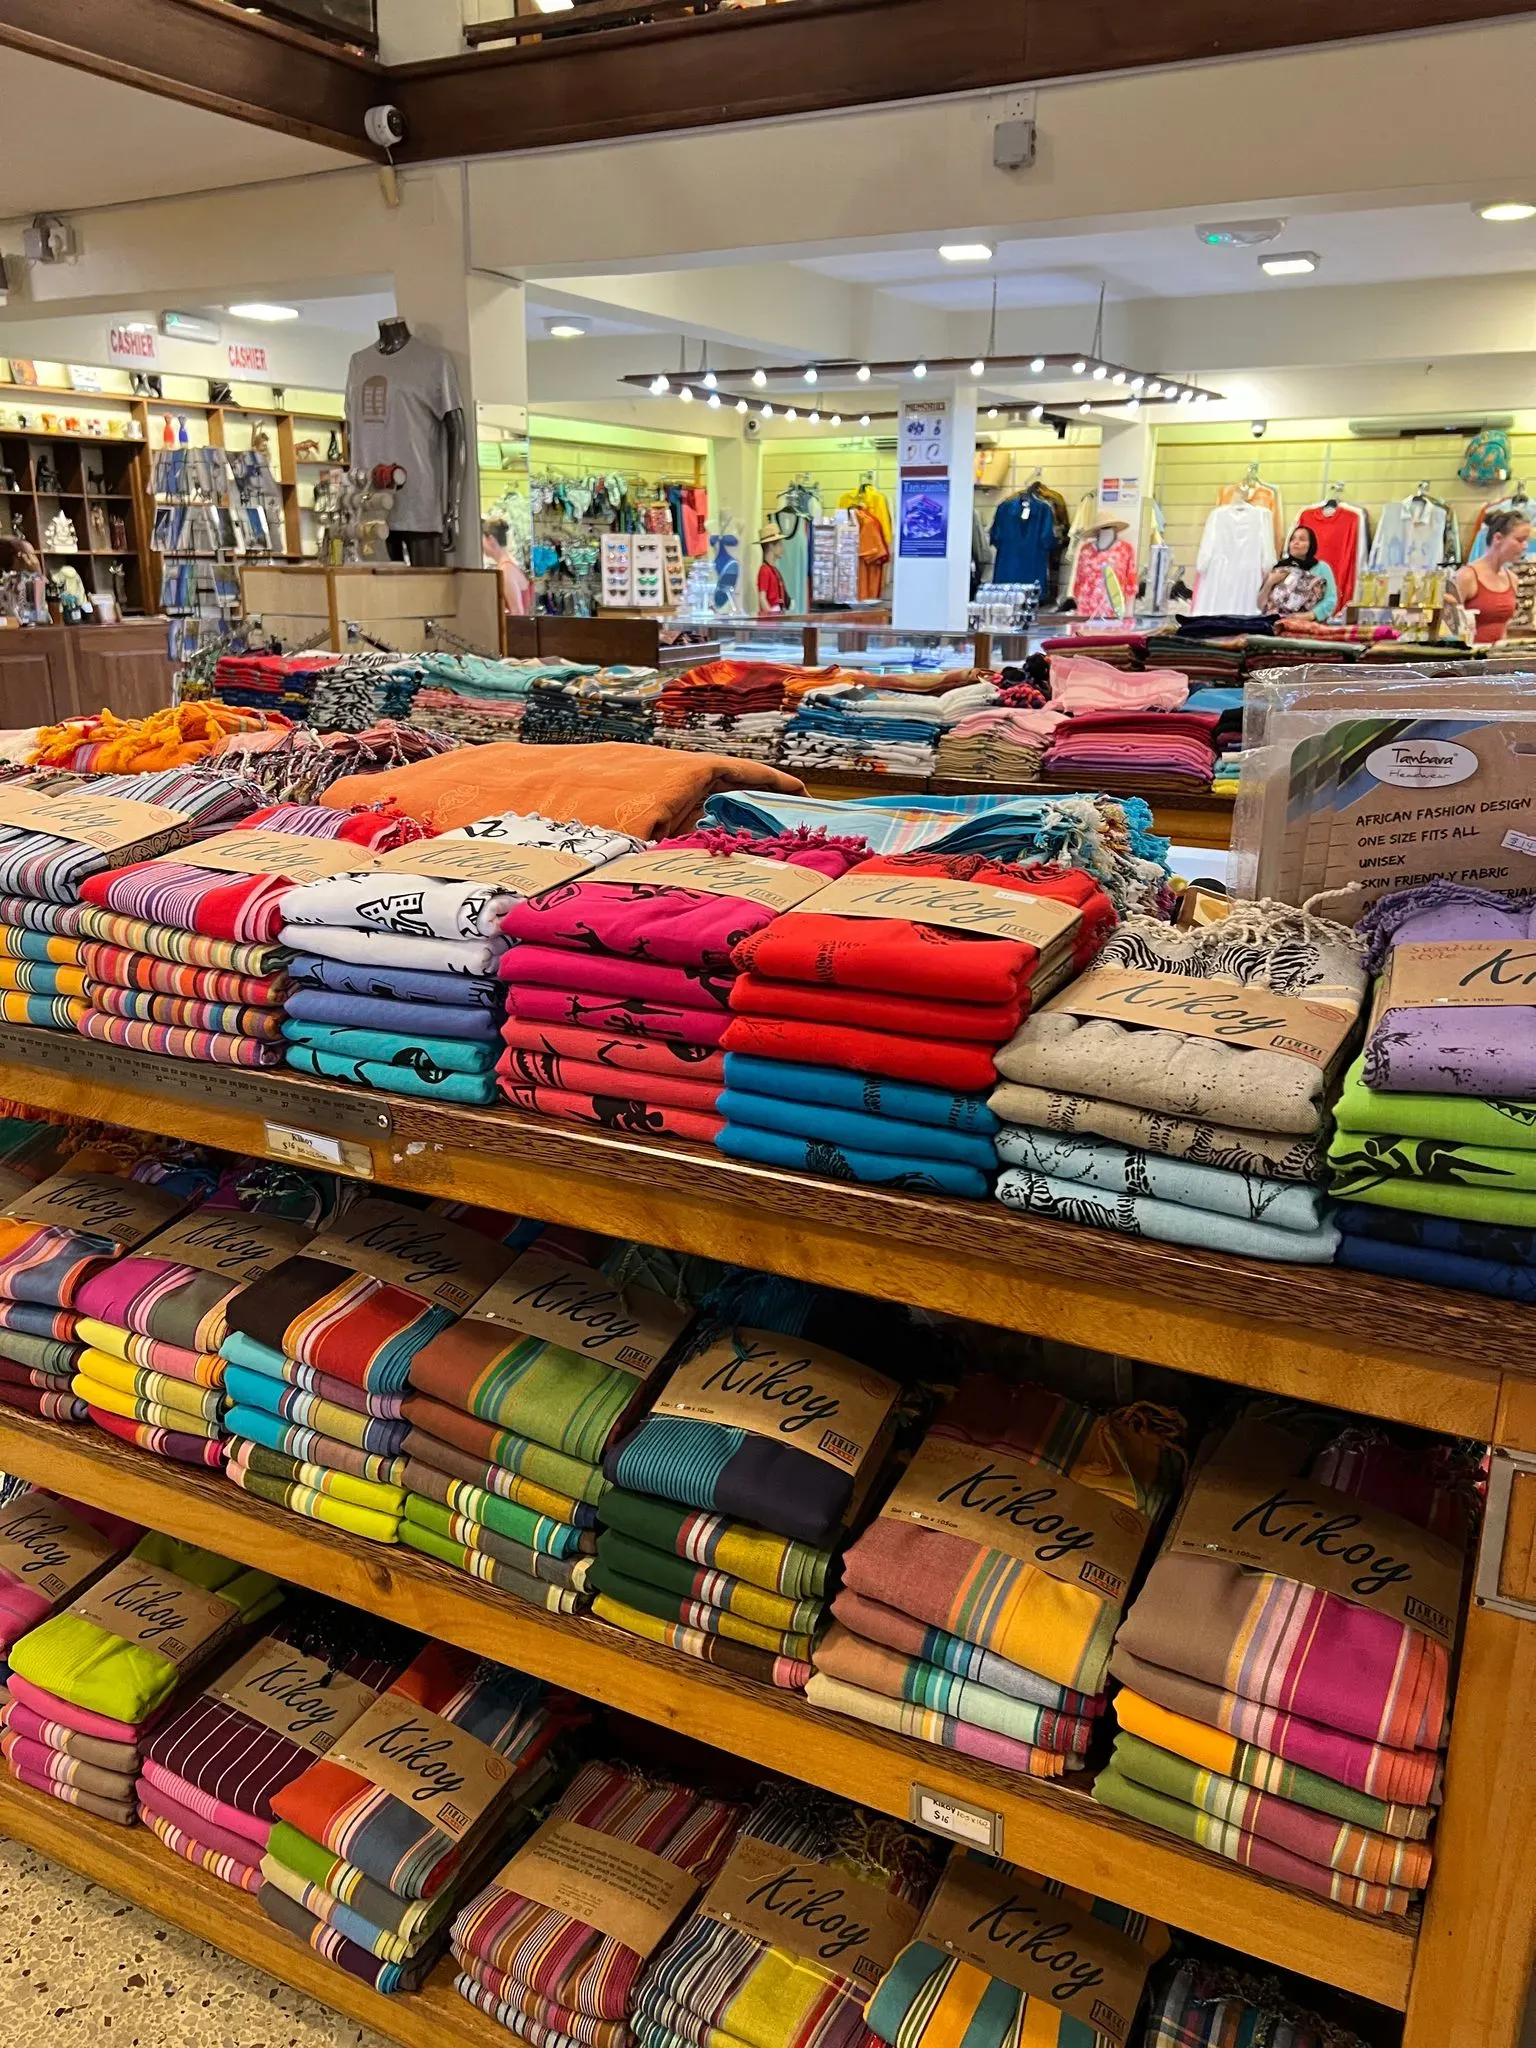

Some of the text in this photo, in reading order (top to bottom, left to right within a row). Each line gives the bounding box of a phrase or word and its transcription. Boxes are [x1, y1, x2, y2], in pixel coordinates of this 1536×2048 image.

[110, 330, 155, 357] CASHIER
[228, 345, 268, 371] CASHIER
[17, 798, 124, 832] Kikoy
[1356, 798, 1531, 826] AFRICAN FASHION DESIGN
[1358, 825, 1480, 848] ONE SIZE FITS ALL
[201, 837, 323, 871] Kikoy
[400, 845, 531, 878] Kikoy
[630, 853, 773, 889] Kikoy
[1359, 855, 1405, 868] UNISEX
[1361, 876, 1390, 890] SKIN
[1462, 867, 1509, 880] FABRIC
[850, 882, 1016, 924] Kikoy
[1096, 979, 1287, 1035] Kikoy
[32, 1178, 137, 1227] Kikoy
[169, 1217, 274, 1268] Kikoy
[345, 1216, 463, 1283] Kikoy
[512, 1273, 640, 1349] Kikoy
[701, 1342, 841, 1433] Kikoy
[822, 1432, 862, 1457] JAHAZI
[936, 1464, 1095, 1561] Kikoy
[0, 1507, 72, 1572] Kikoy
[1231, 1488, 1414, 1595] Kikoy
[1082, 1562, 1124, 1590] JAHAZI
[102, 1575, 189, 1639] Kikoy
[245, 1660, 338, 1732] Kikoy
[364, 1718, 465, 1801] Kikoy
[746, 1867, 871, 1959] Kikoy
[968, 1894, 1104, 2001] Kikoy
